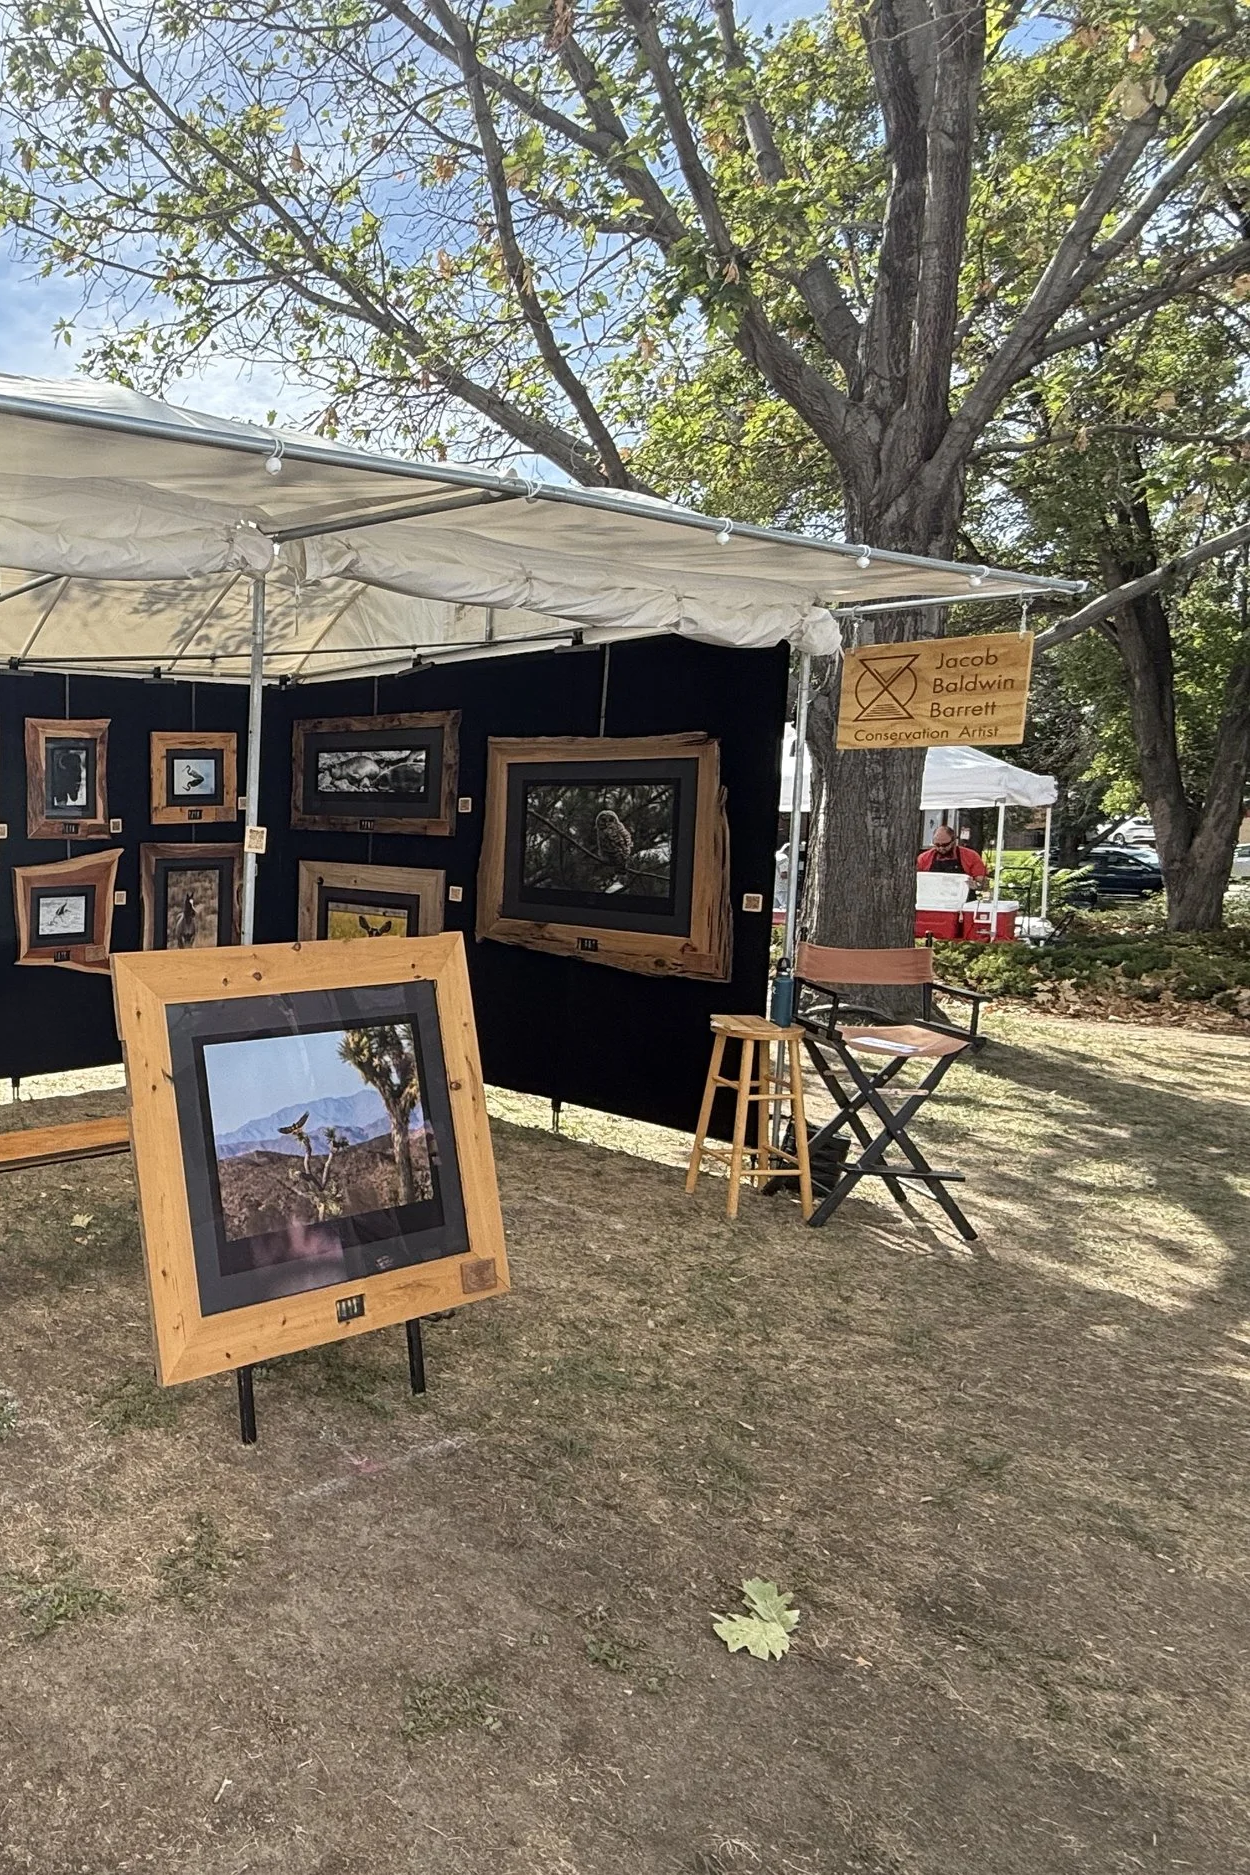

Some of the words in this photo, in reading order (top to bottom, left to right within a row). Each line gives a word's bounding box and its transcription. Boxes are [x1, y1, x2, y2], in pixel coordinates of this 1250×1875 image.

[935, 648, 998, 669] Jacob
[932, 674, 1015, 694] Baldwin
[930, 702, 996, 718] Barrett
[854, 728, 949, 742] Conservation
[958, 726, 999, 739] Artist
